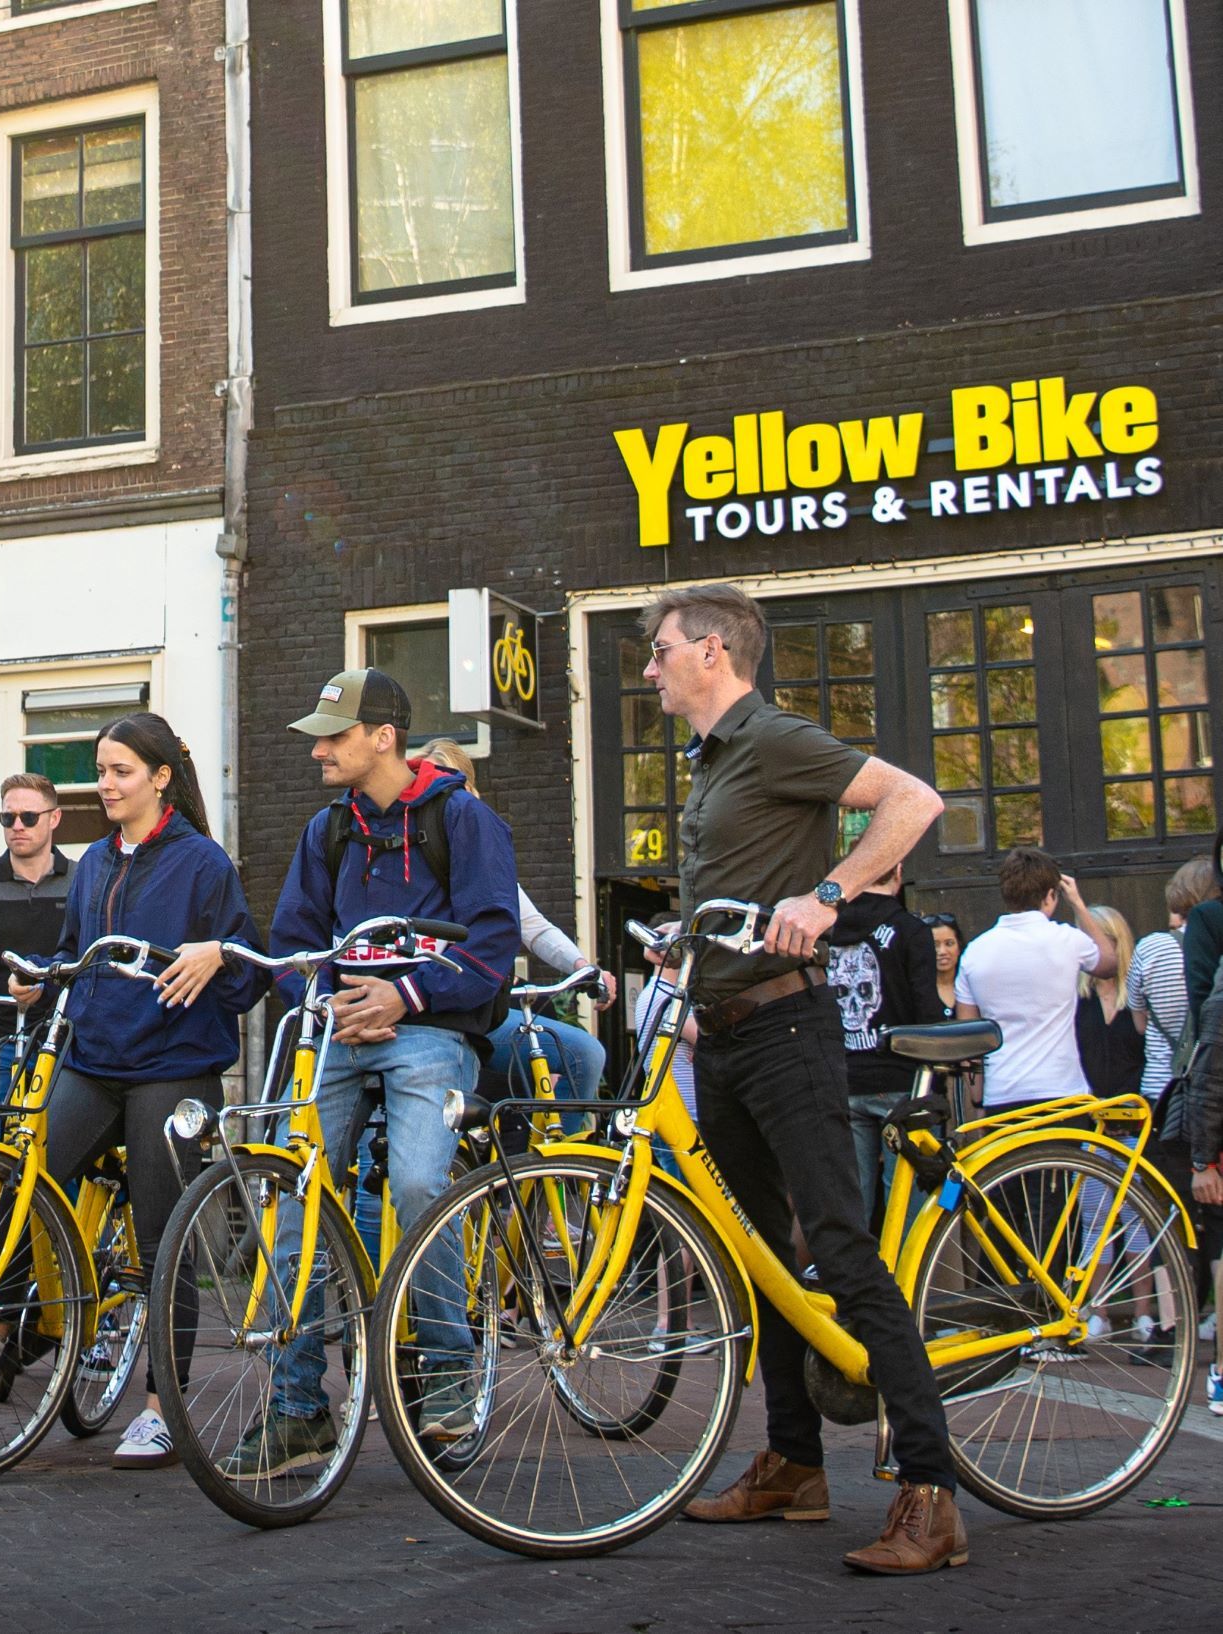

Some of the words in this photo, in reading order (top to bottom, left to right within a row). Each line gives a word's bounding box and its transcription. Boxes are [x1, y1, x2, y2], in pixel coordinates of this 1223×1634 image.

[613, 410, 924, 547] Yellow
[951, 376, 1160, 471] Bike
[685, 491, 849, 542] TOURS
[872, 486, 908, 523] &
[930, 456, 1164, 517] RENTALS
[631, 828, 662, 860] 29
[687, 1132, 733, 1201] YELLOW
